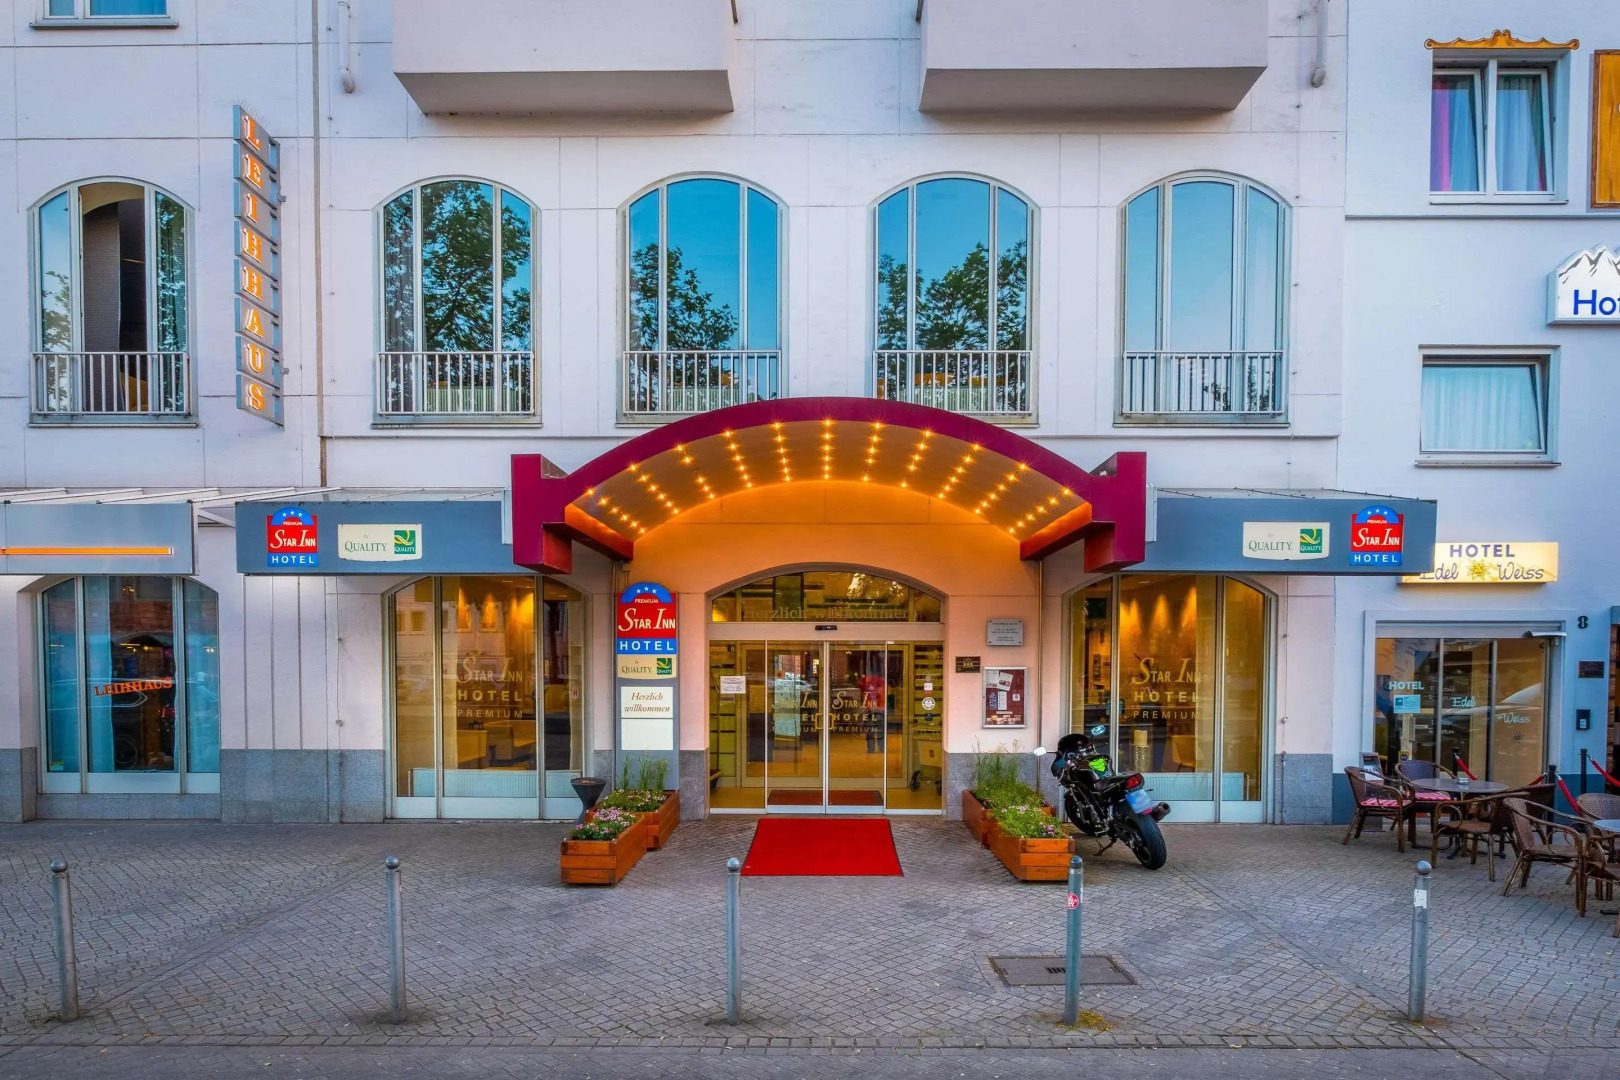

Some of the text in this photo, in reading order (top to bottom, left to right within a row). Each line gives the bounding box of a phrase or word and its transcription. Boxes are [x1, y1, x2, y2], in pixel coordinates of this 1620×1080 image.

[243, 115, 264, 411] LEIHHAUS
[1450, 544, 1515, 558] HOTEL
[272, 556, 314, 564] HOTEL
[1354, 554, 1398, 562] HOTEL
[1497, 562, 1544, 580] Weiss
[1578, 616, 1588, 629] 8
[620, 640, 674, 650] HOTEL
[94, 676, 172, 696] LEIHHAUS
[1388, 682, 1424, 690] HOTEL
[458, 690, 522, 702] HOTEL
[631, 692, 664, 700] Herzlich
[1134, 691, 1200, 702] HOTEL
[1452, 696, 1476, 707] Edel
[624, 704, 670, 712] willkommen
[458, 710, 522, 718] PREMIUM
[834, 714, 877, 722] HOTEL
